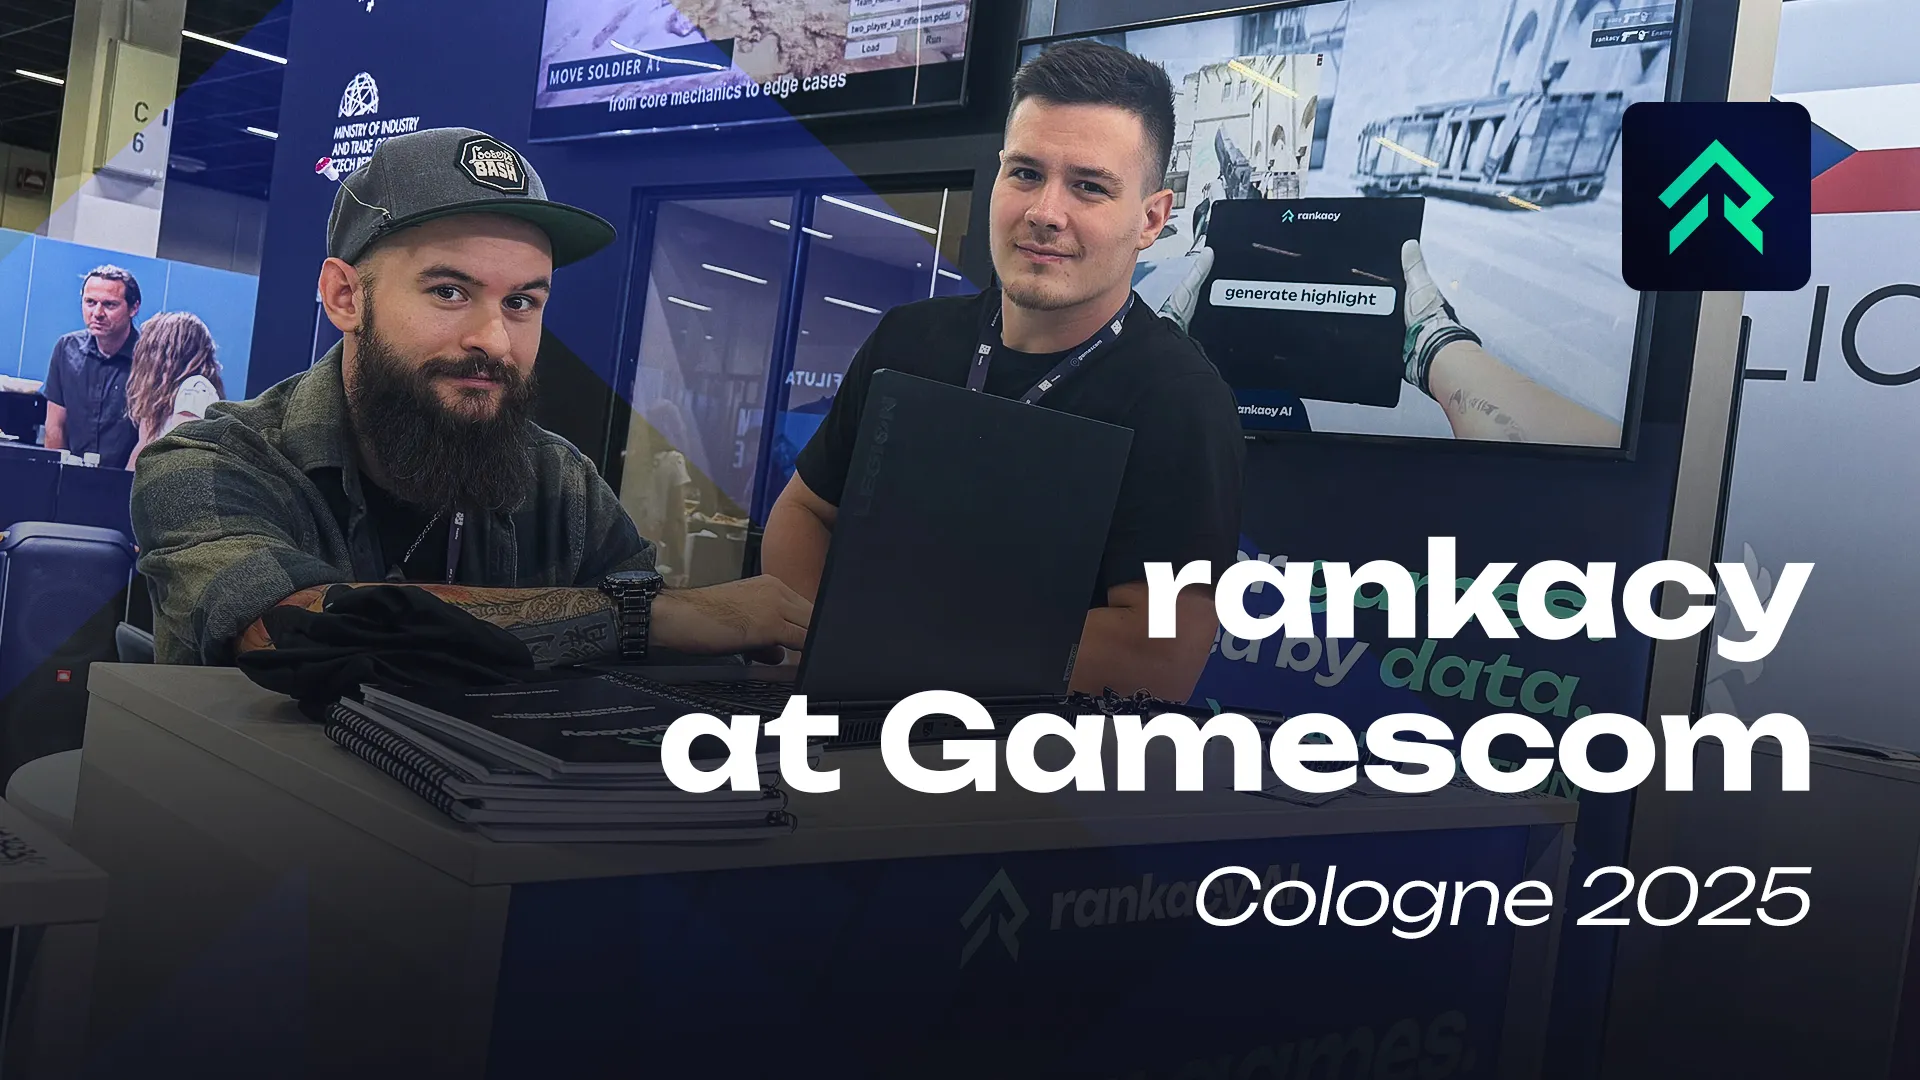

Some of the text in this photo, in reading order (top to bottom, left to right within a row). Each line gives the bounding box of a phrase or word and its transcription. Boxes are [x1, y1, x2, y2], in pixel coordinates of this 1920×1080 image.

[861, 43, 880, 54] Load
[925, 35, 942, 45] Run
[549, 66, 584, 86] MOVE
[587, 58, 641, 80] SOLDIER
[609, 71, 847, 112] from core mechanics to edge cases
[134, 101, 149, 123] C
[333, 116, 420, 140] MINISTRY OF INDUSTRY
[132, 131, 145, 154] 6
[331, 142, 350, 156] AND
[350, 138, 374, 155] TRADE
[473, 160, 518, 183] BASH
[1297, 211, 1341, 223] rankacy
[1224, 287, 1377, 307] generate highlight
[1275, 630, 1370, 688] by
[1378, 638, 1593, 720] data.
[1049, 872, 1251, 931] rankacy
[1173, 1009, 1478, 1080] ames.
